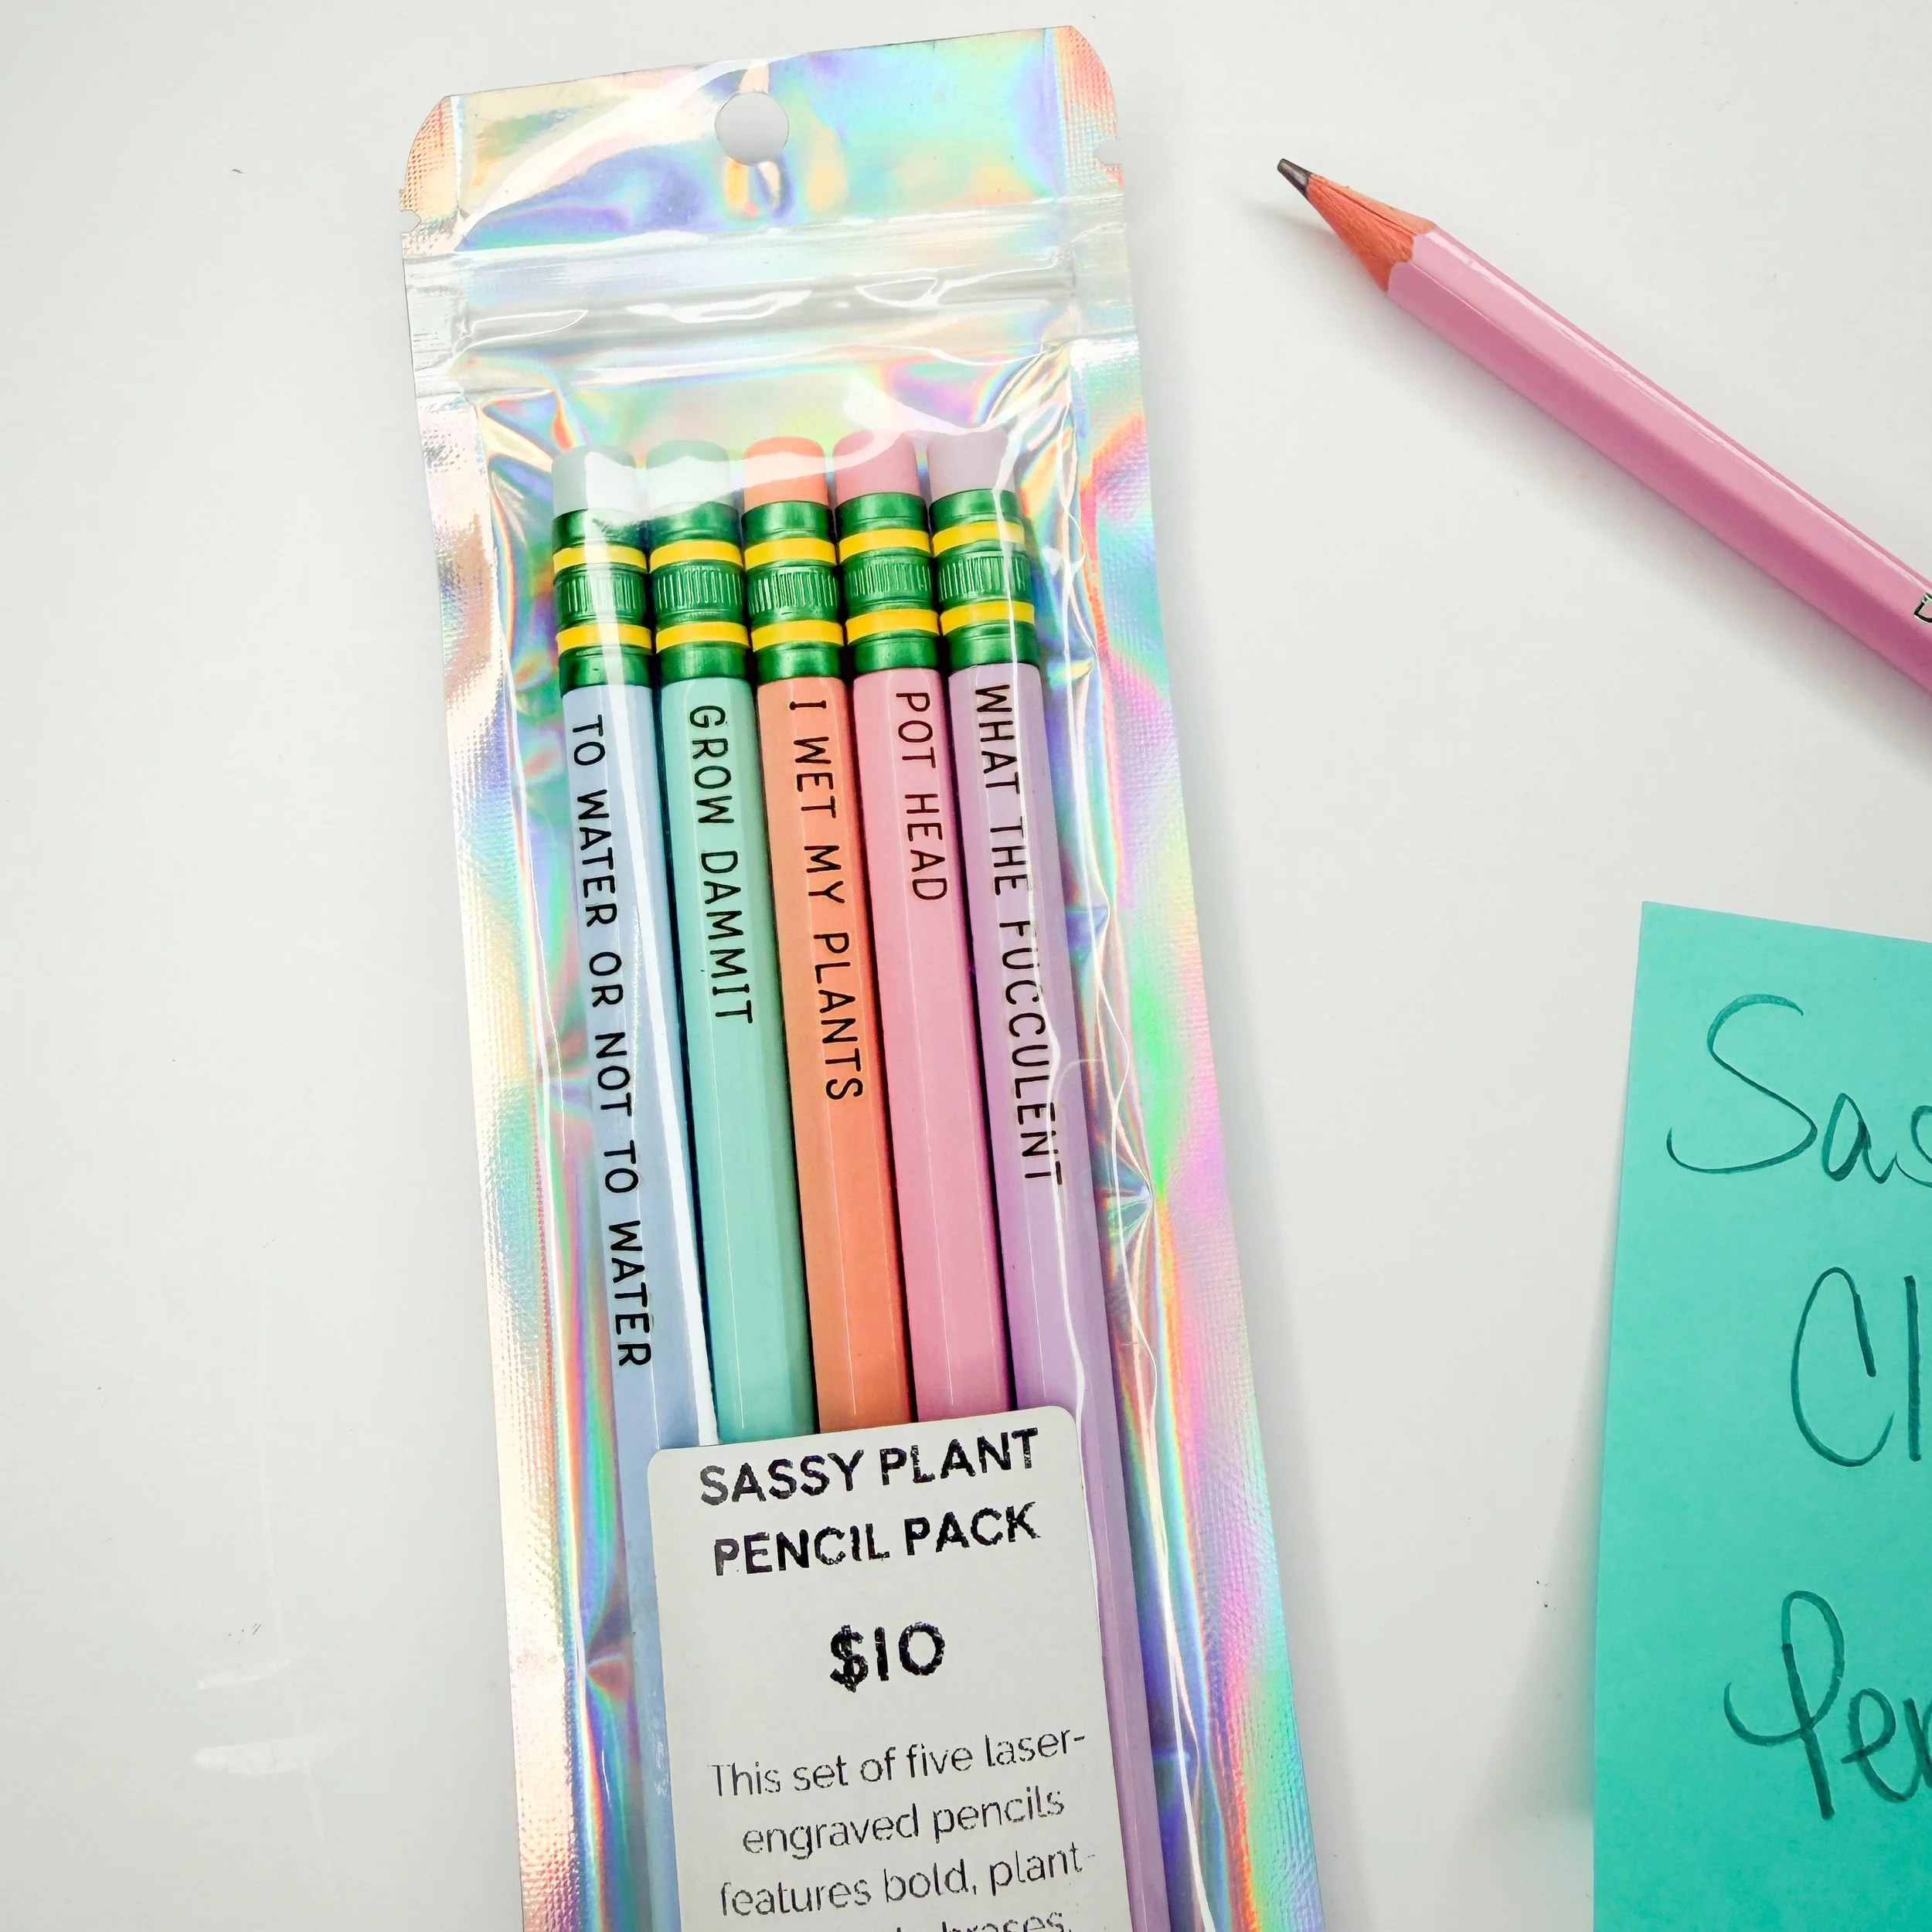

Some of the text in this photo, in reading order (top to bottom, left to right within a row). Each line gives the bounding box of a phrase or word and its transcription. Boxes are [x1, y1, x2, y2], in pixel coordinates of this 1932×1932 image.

[896, 691, 947, 901] POT HEAD
[689, 704, 753, 1024] GROW DAMMIT
[789, 699, 863, 1101] I WET MY PLANTS
[975, 684, 1063, 1186] WHAT THE FUCCULENT
[572, 714, 652, 1367] TO WATER OR NOT TO WATER
[699, 1427, 1039, 1507] SASSY PLANT
[713, 1501, 1042, 1577] PENCIL PACK
[829, 1621, 946, 1693] $10
[709, 1727, 1086, 1798] This set of five laser-
[743, 1785, 1065, 1860] engraved pencils
[721, 1876, 872, 1917] features
[883, 1859, 978, 1903] bold,
